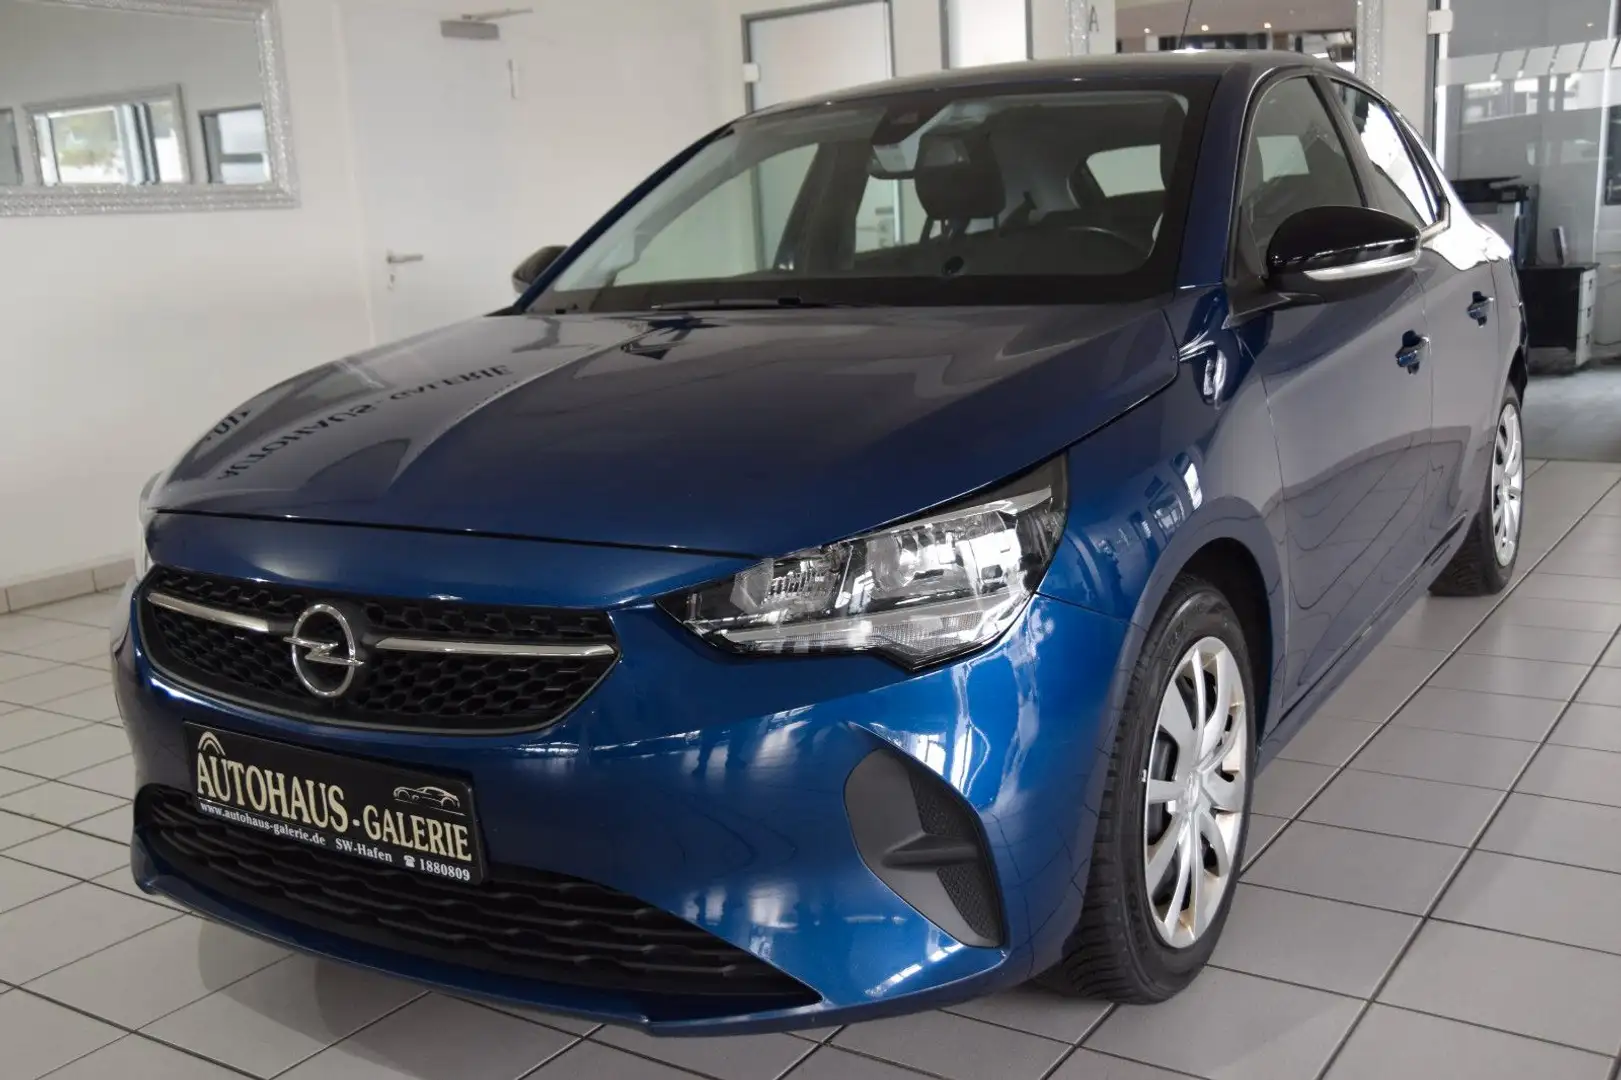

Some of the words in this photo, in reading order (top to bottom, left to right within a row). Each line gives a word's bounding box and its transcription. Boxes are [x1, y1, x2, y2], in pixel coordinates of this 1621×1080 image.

[199, 802, 326, 846] www.autohaus-galerie.de
[335, 838, 393, 863] SW-Hafen
[419, 858, 471, 882] 1880809
